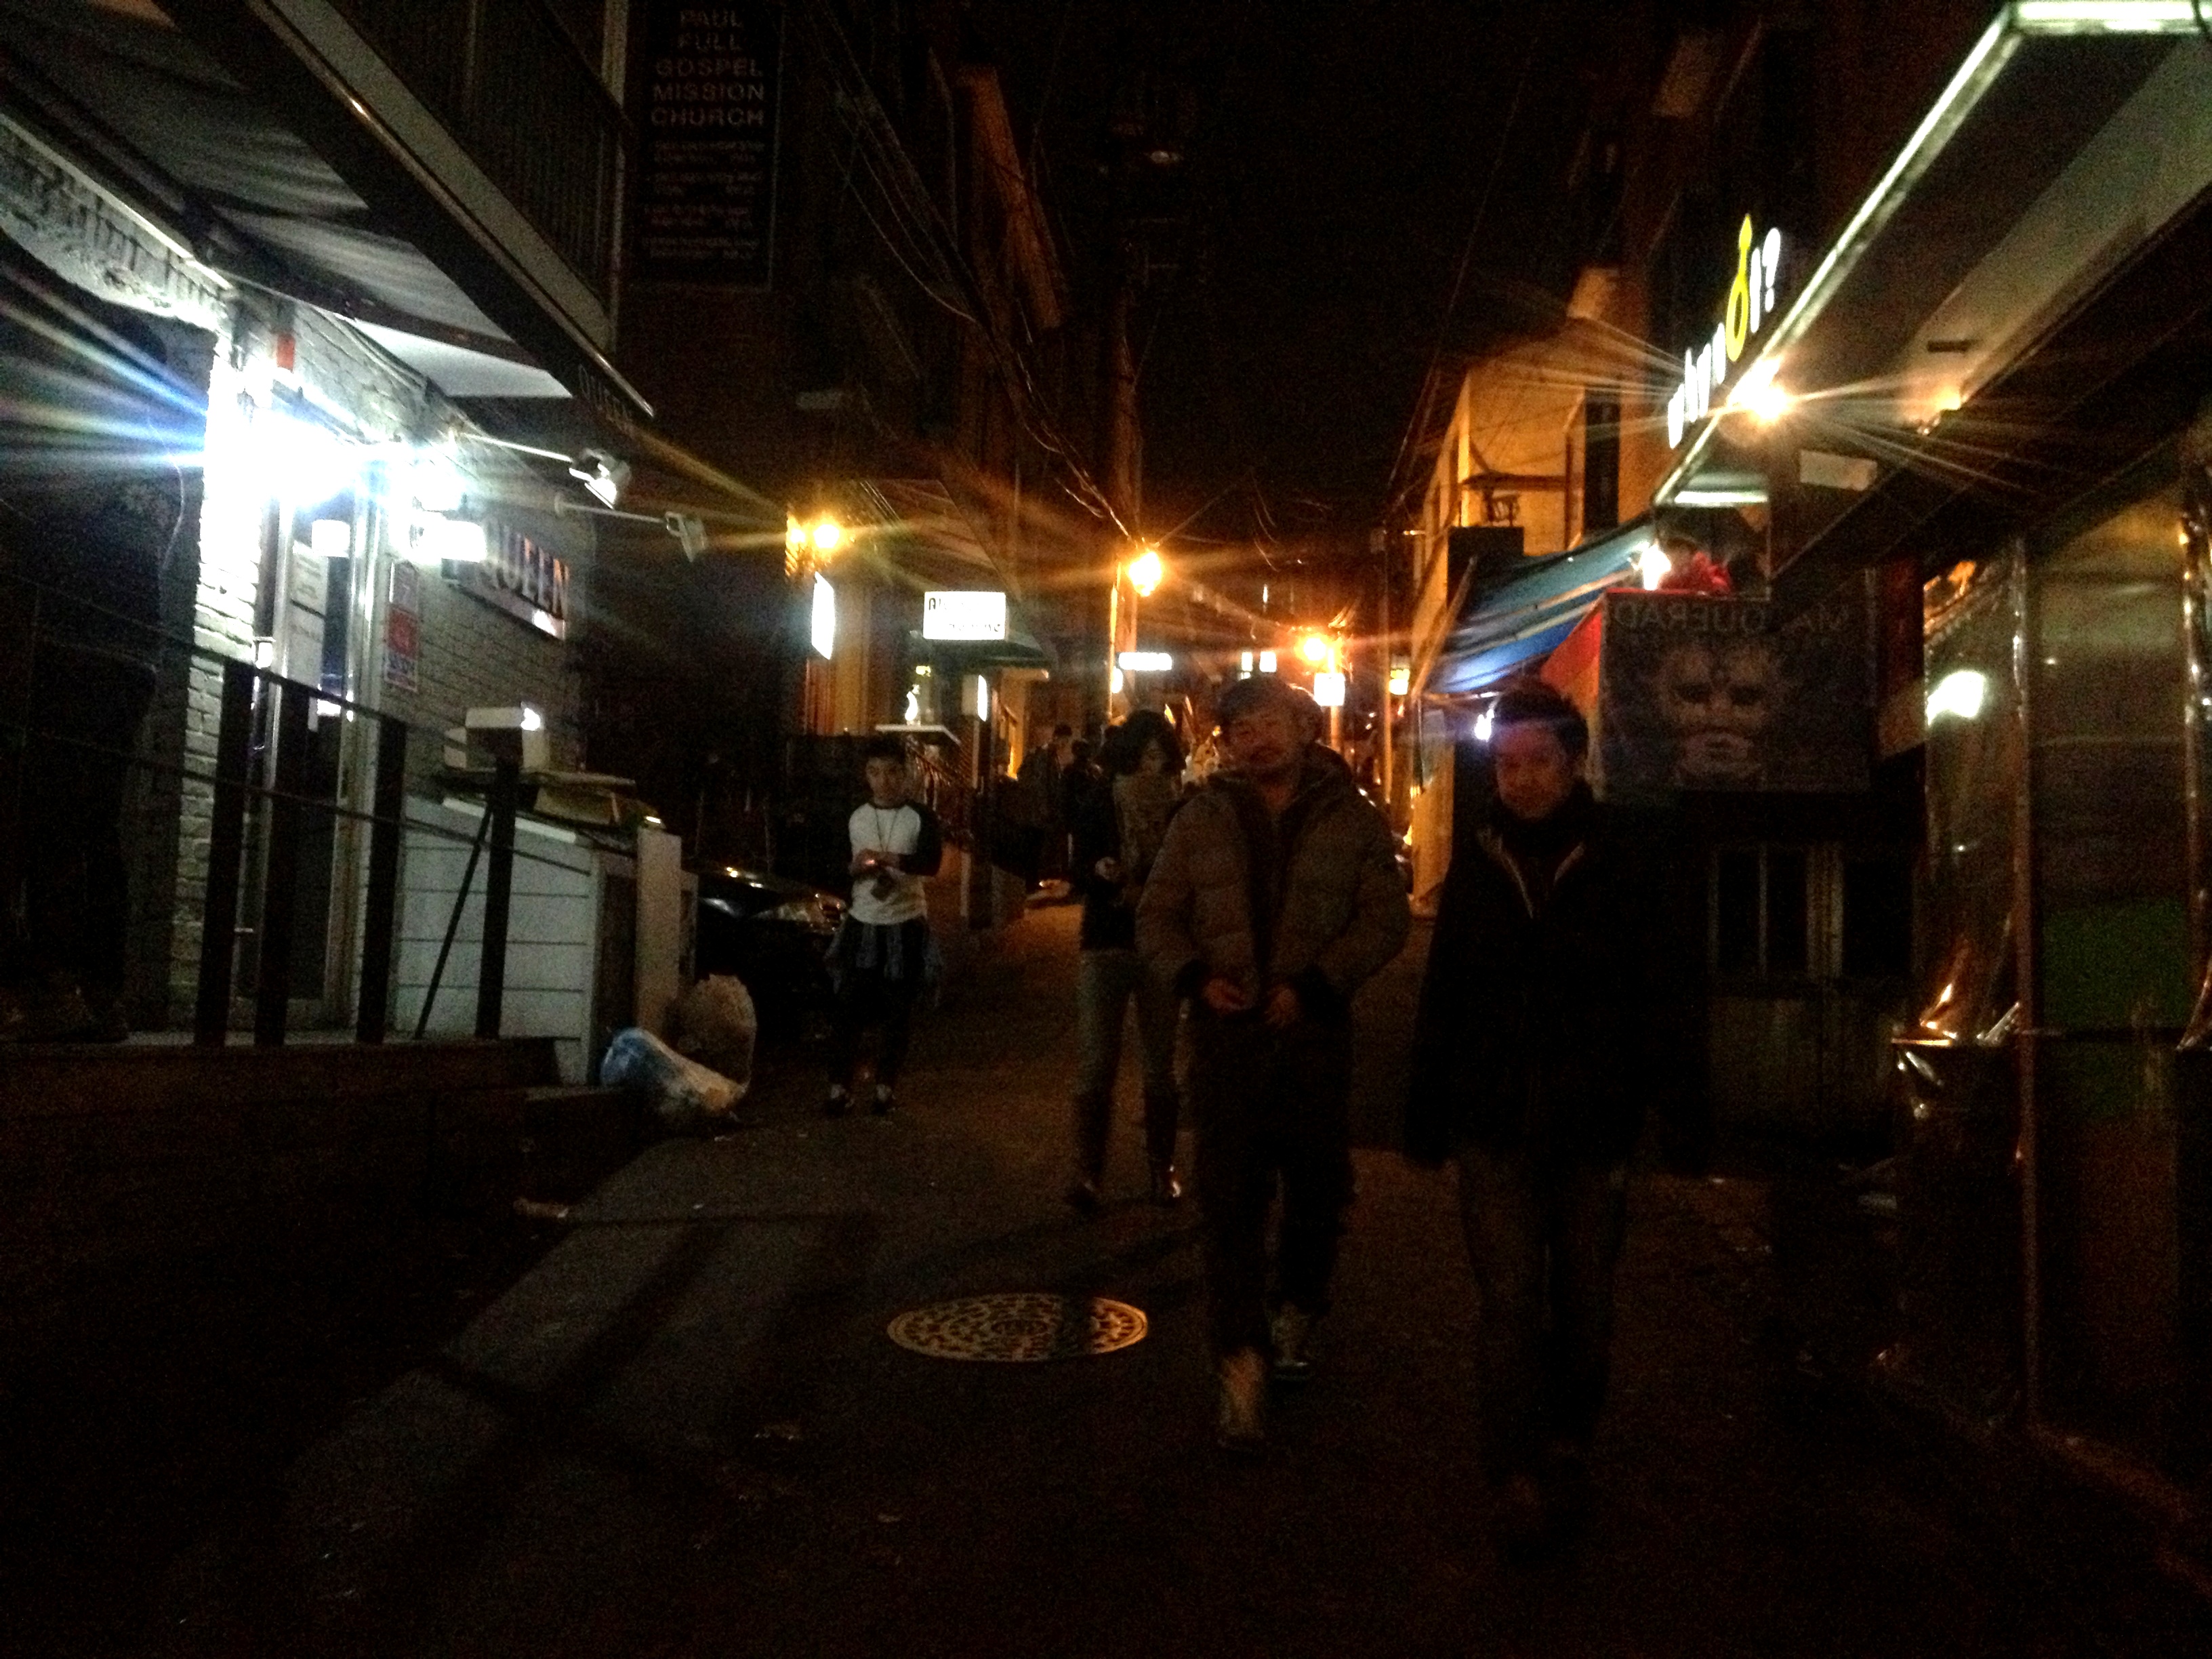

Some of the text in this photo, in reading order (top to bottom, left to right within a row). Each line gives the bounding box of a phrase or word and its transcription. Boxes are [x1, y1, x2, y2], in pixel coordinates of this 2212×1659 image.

[679, 9, 744, 28] PAUL
[677, 33, 742, 52] FULL
[655, 58, 764, 77] GOSPEL
[652, 82, 765, 102] MISSION
[650, 107, 765, 127] CHURCH
